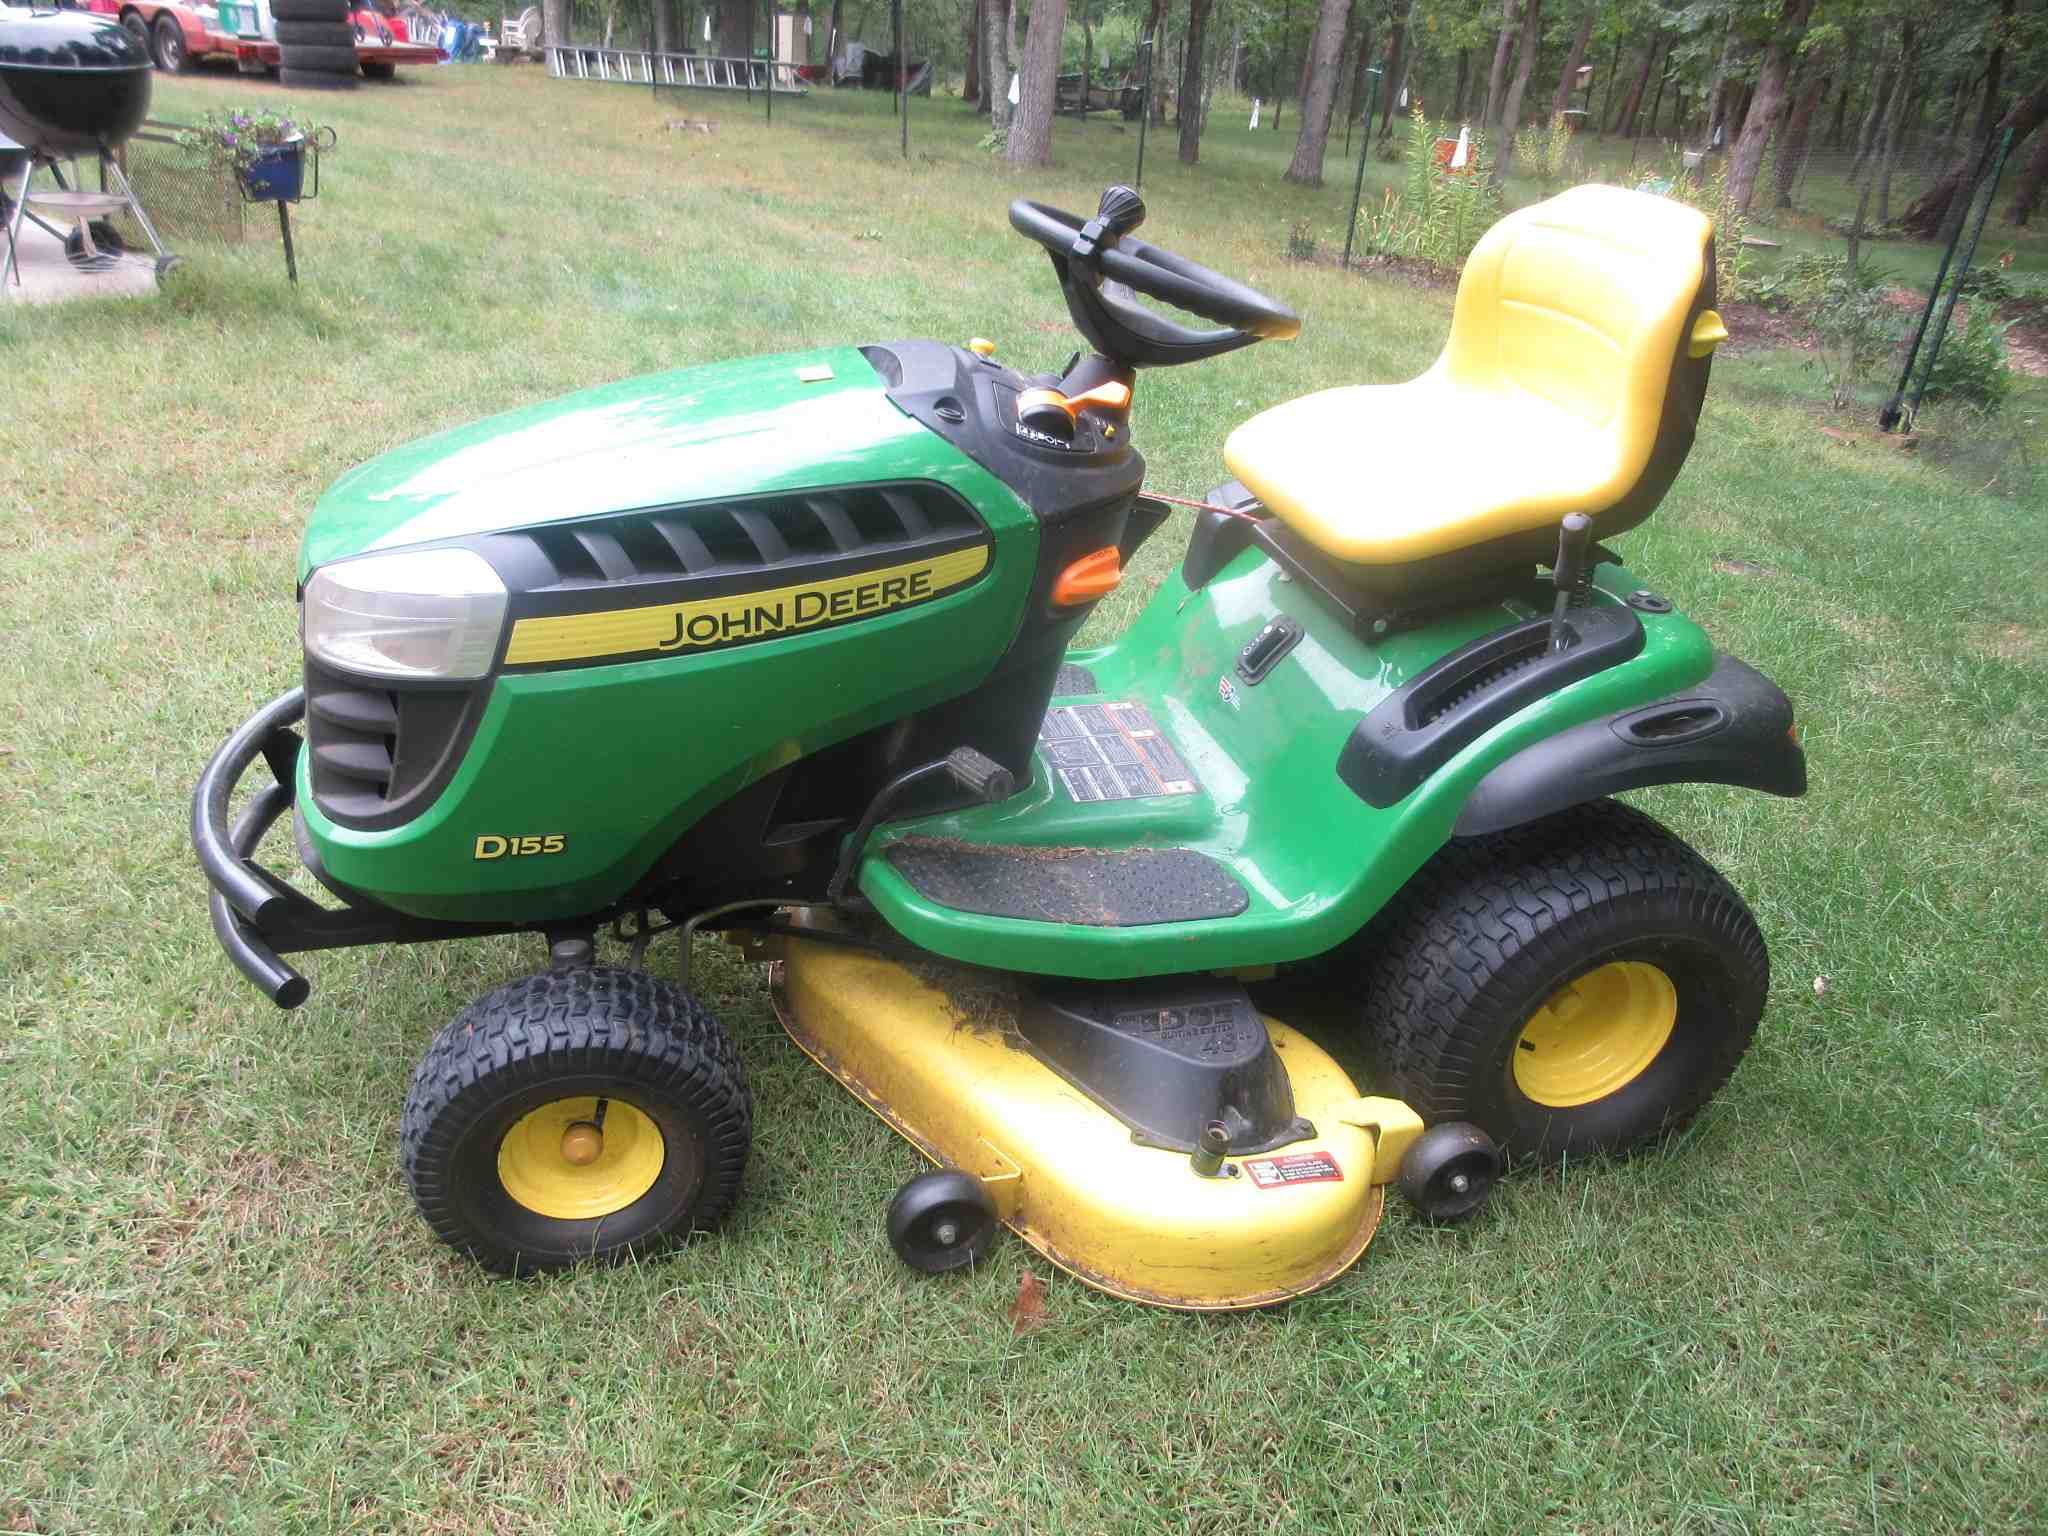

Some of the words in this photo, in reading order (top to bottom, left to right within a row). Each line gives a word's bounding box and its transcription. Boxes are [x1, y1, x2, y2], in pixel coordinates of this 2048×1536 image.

[659, 603, 784, 647] JOHN
[795, 569, 932, 625] DEERE
[474, 835, 566, 859] D155
